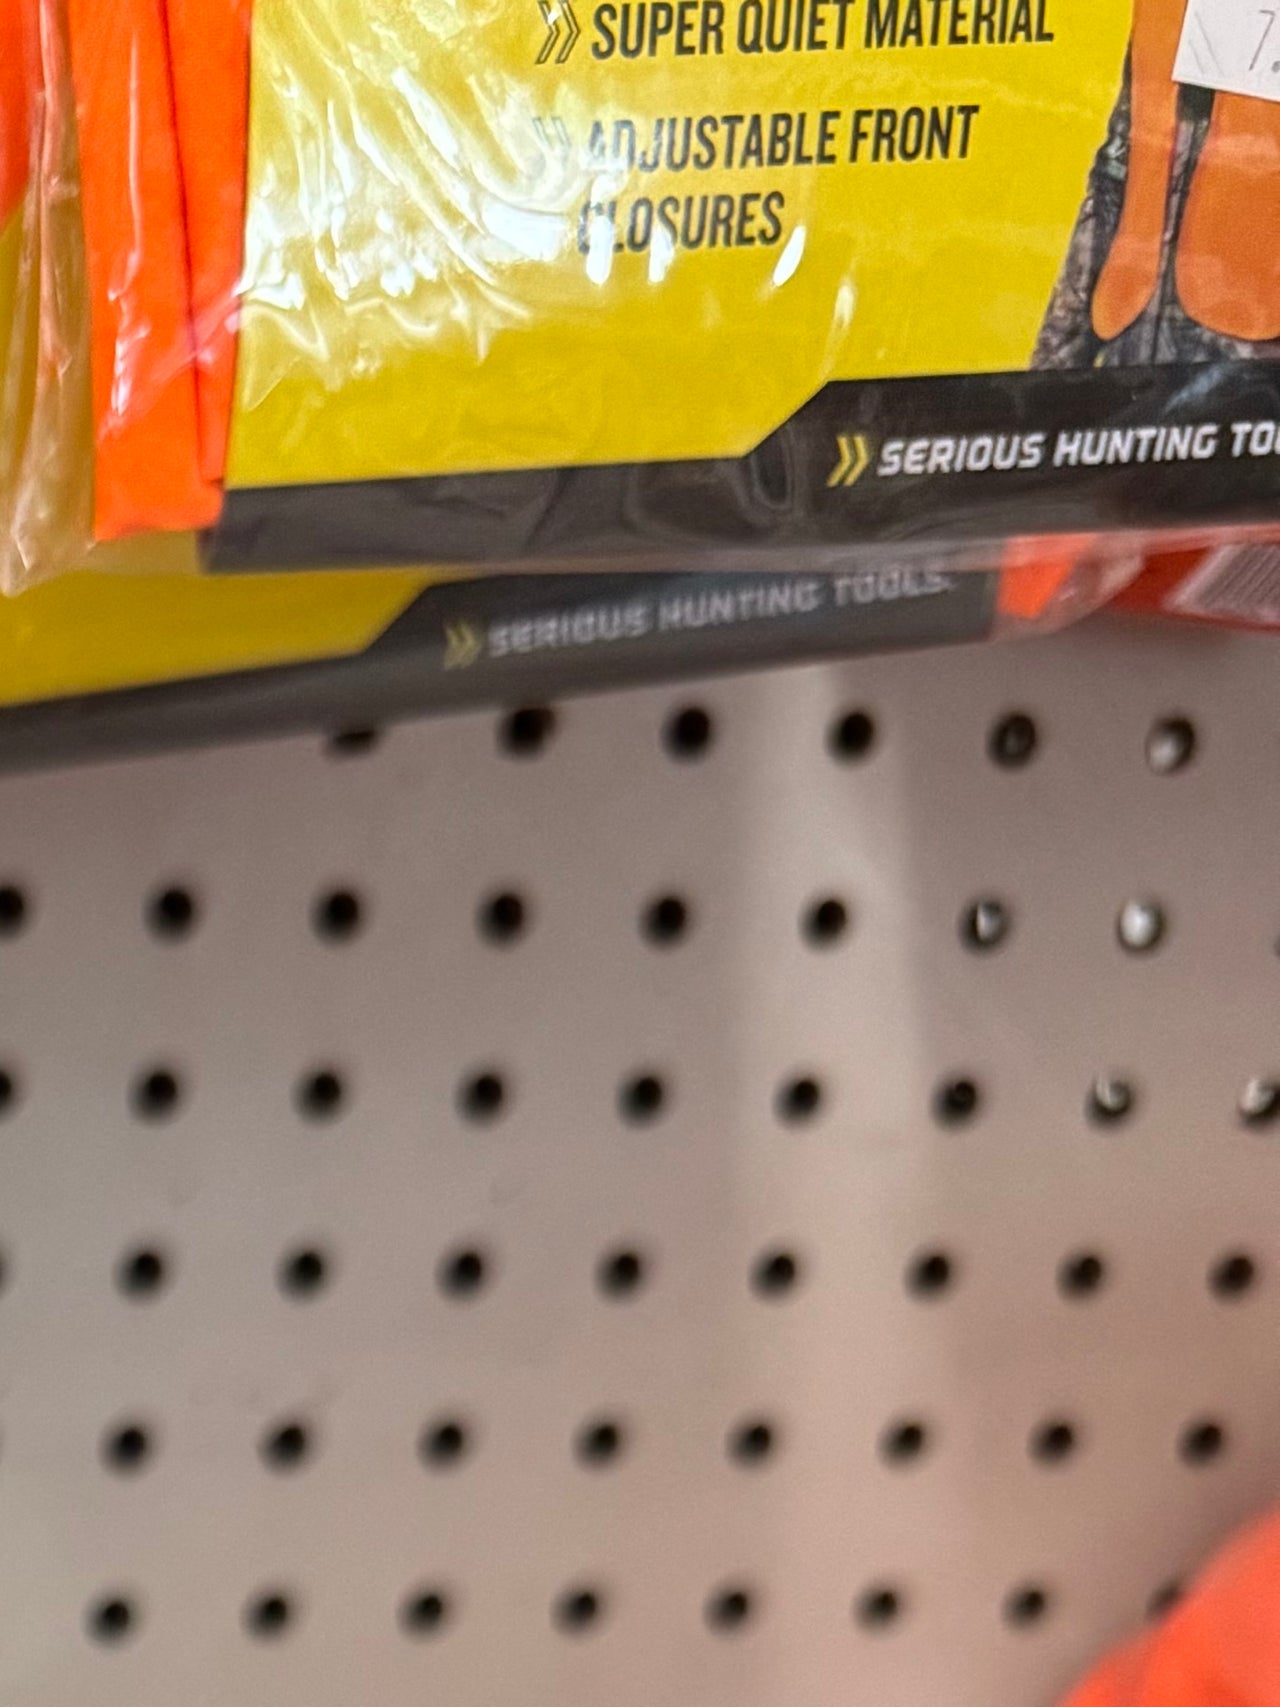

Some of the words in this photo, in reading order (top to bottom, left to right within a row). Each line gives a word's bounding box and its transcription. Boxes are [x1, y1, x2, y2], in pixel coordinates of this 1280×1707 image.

[591, 0, 724, 60] SUPER
[736, 0, 855, 53] QUIET
[864, 0, 1055, 49] MATERIAL
[587, 112, 839, 172] ADJUSTABLE
[849, 105, 980, 163] FRONT
[577, 191, 785, 255] CLOSURES
[877, 434, 1043, 476] SERIOUS
[1053, 424, 1220, 467] HUNTING
[1230, 420, 1280, 458] TO
[488, 604, 647, 657] SERIOUS
[657, 580, 820, 631] HUNTING
